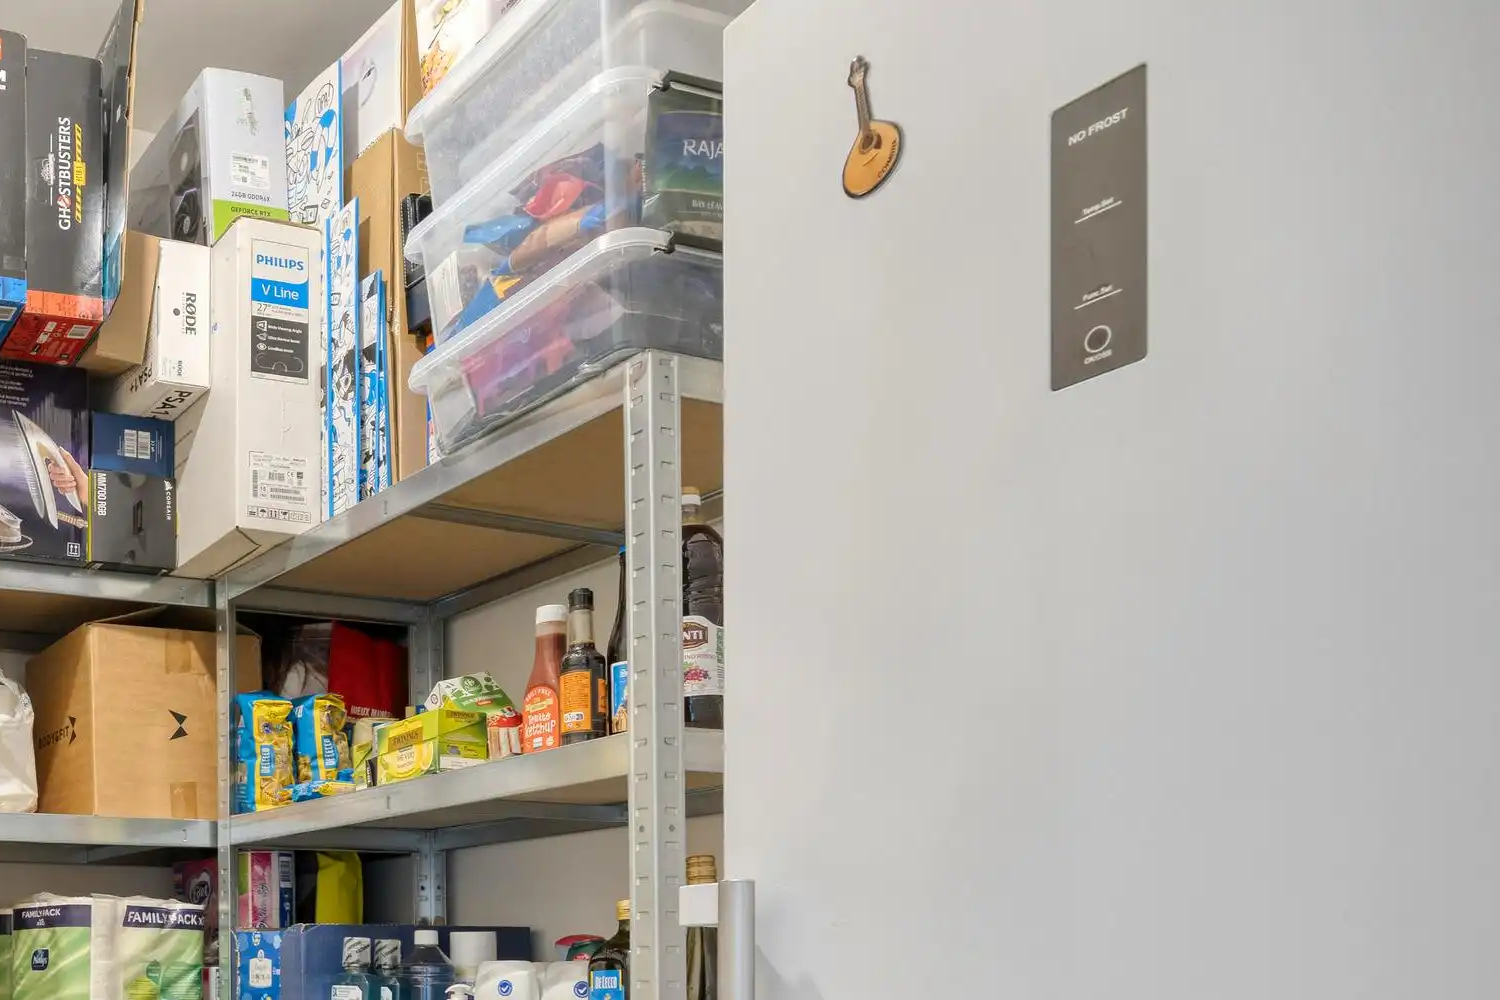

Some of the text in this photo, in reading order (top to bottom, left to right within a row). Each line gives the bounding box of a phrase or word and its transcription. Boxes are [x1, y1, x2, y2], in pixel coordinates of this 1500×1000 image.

[1068, 108, 1128, 146] NO FROST
[231, 207, 258, 215] GEFORCE
[256, 254, 304, 271] PHILIPS
[262, 284, 299, 300] V Line
[185, 292, 197, 335] RØDE
[151, 390, 193, 418] PSA1
[97, 473, 107, 516] MM700 RGB
[683, 630, 704, 640] NTI
